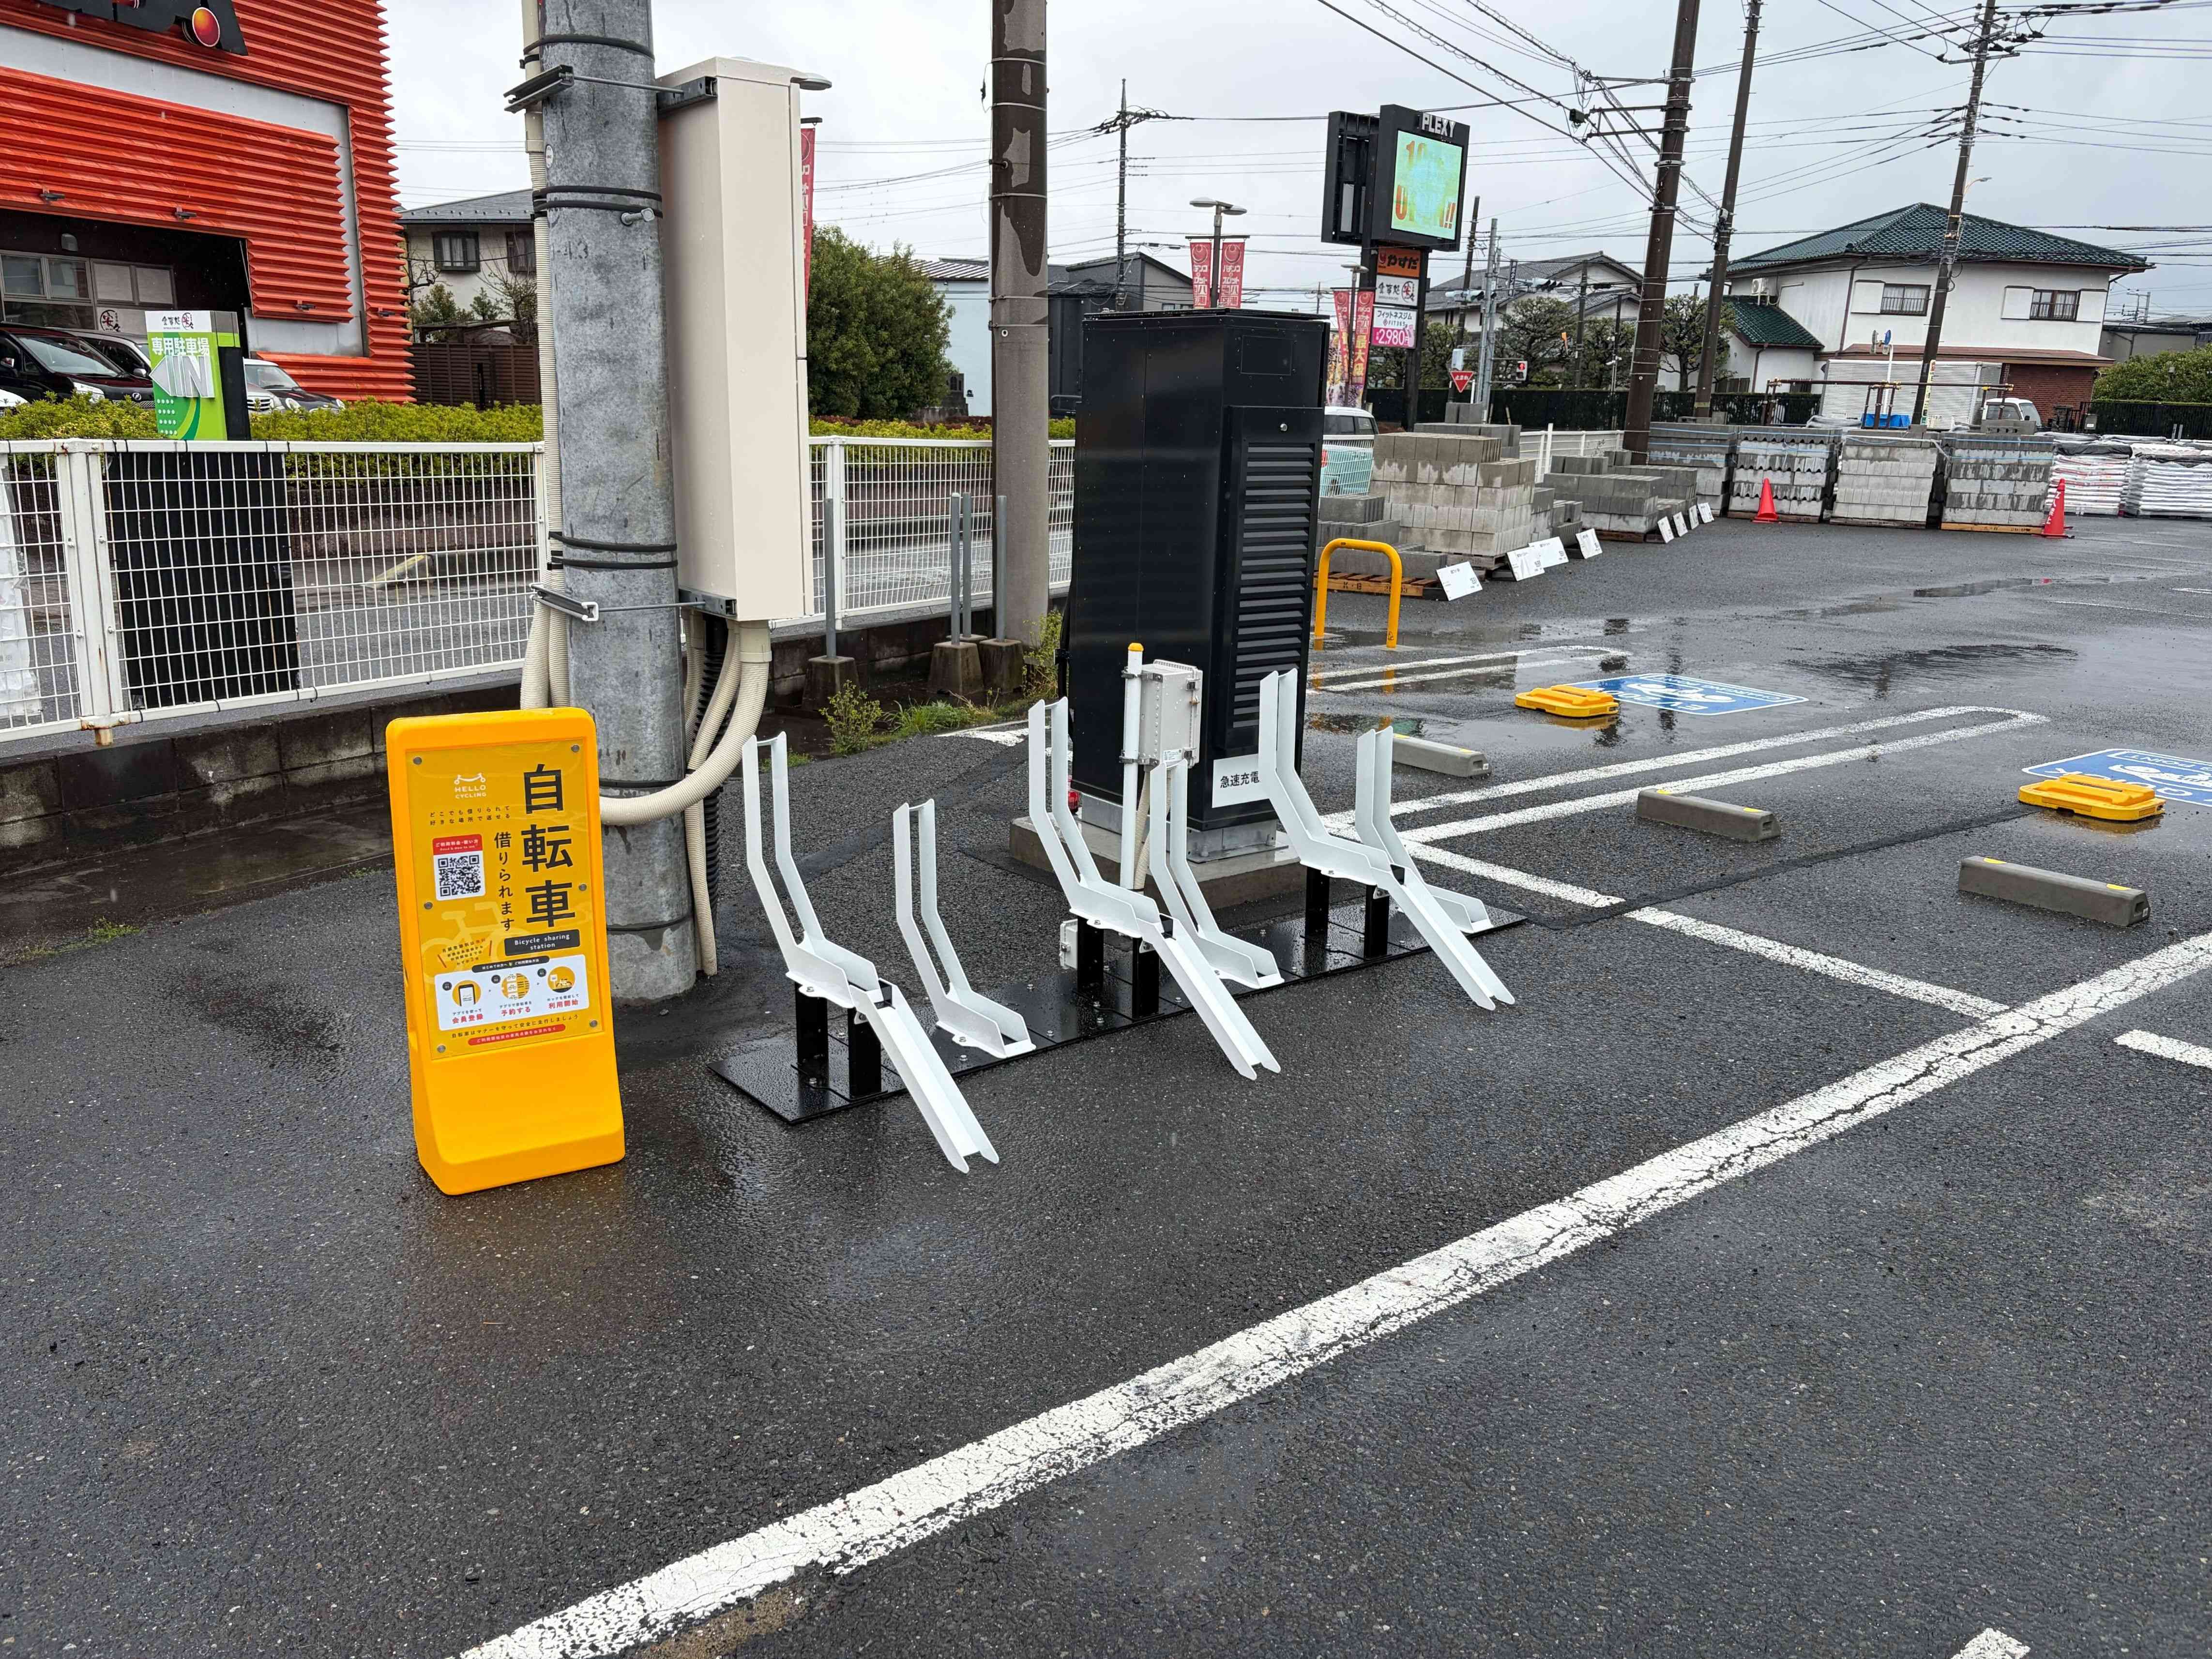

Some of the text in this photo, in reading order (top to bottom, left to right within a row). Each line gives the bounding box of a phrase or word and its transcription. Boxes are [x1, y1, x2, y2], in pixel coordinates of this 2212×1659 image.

[1422, 113, 1456, 138] PLEXY
[1387, 255, 1419, 270] やすだ
[1379, 282, 1400, 295] 食事処
[1377, 310, 1412, 320] フィットネスジム
[151, 337, 210, 356] 専用駐車場
[1656, 702, 1708, 710] EV
[2130, 755, 2195, 768] POINT
[1220, 771, 1260, 788] 急速充電
[455, 784, 486, 793] HELLO
[430, 805, 510, 817] どこでも借りられて
[430, 814, 510, 826] 好きな場所で返せる
[520, 764, 576, 928] 自転車
[493, 831, 515, 933] 借りられます
[514, 933, 570, 946] Bicycle sharing
[530, 942, 556, 950] station
[548, 999, 578, 1009] 利用開始
[500, 1006, 531, 1017] 予約する
[452, 1013, 484, 1024] 会員登録
